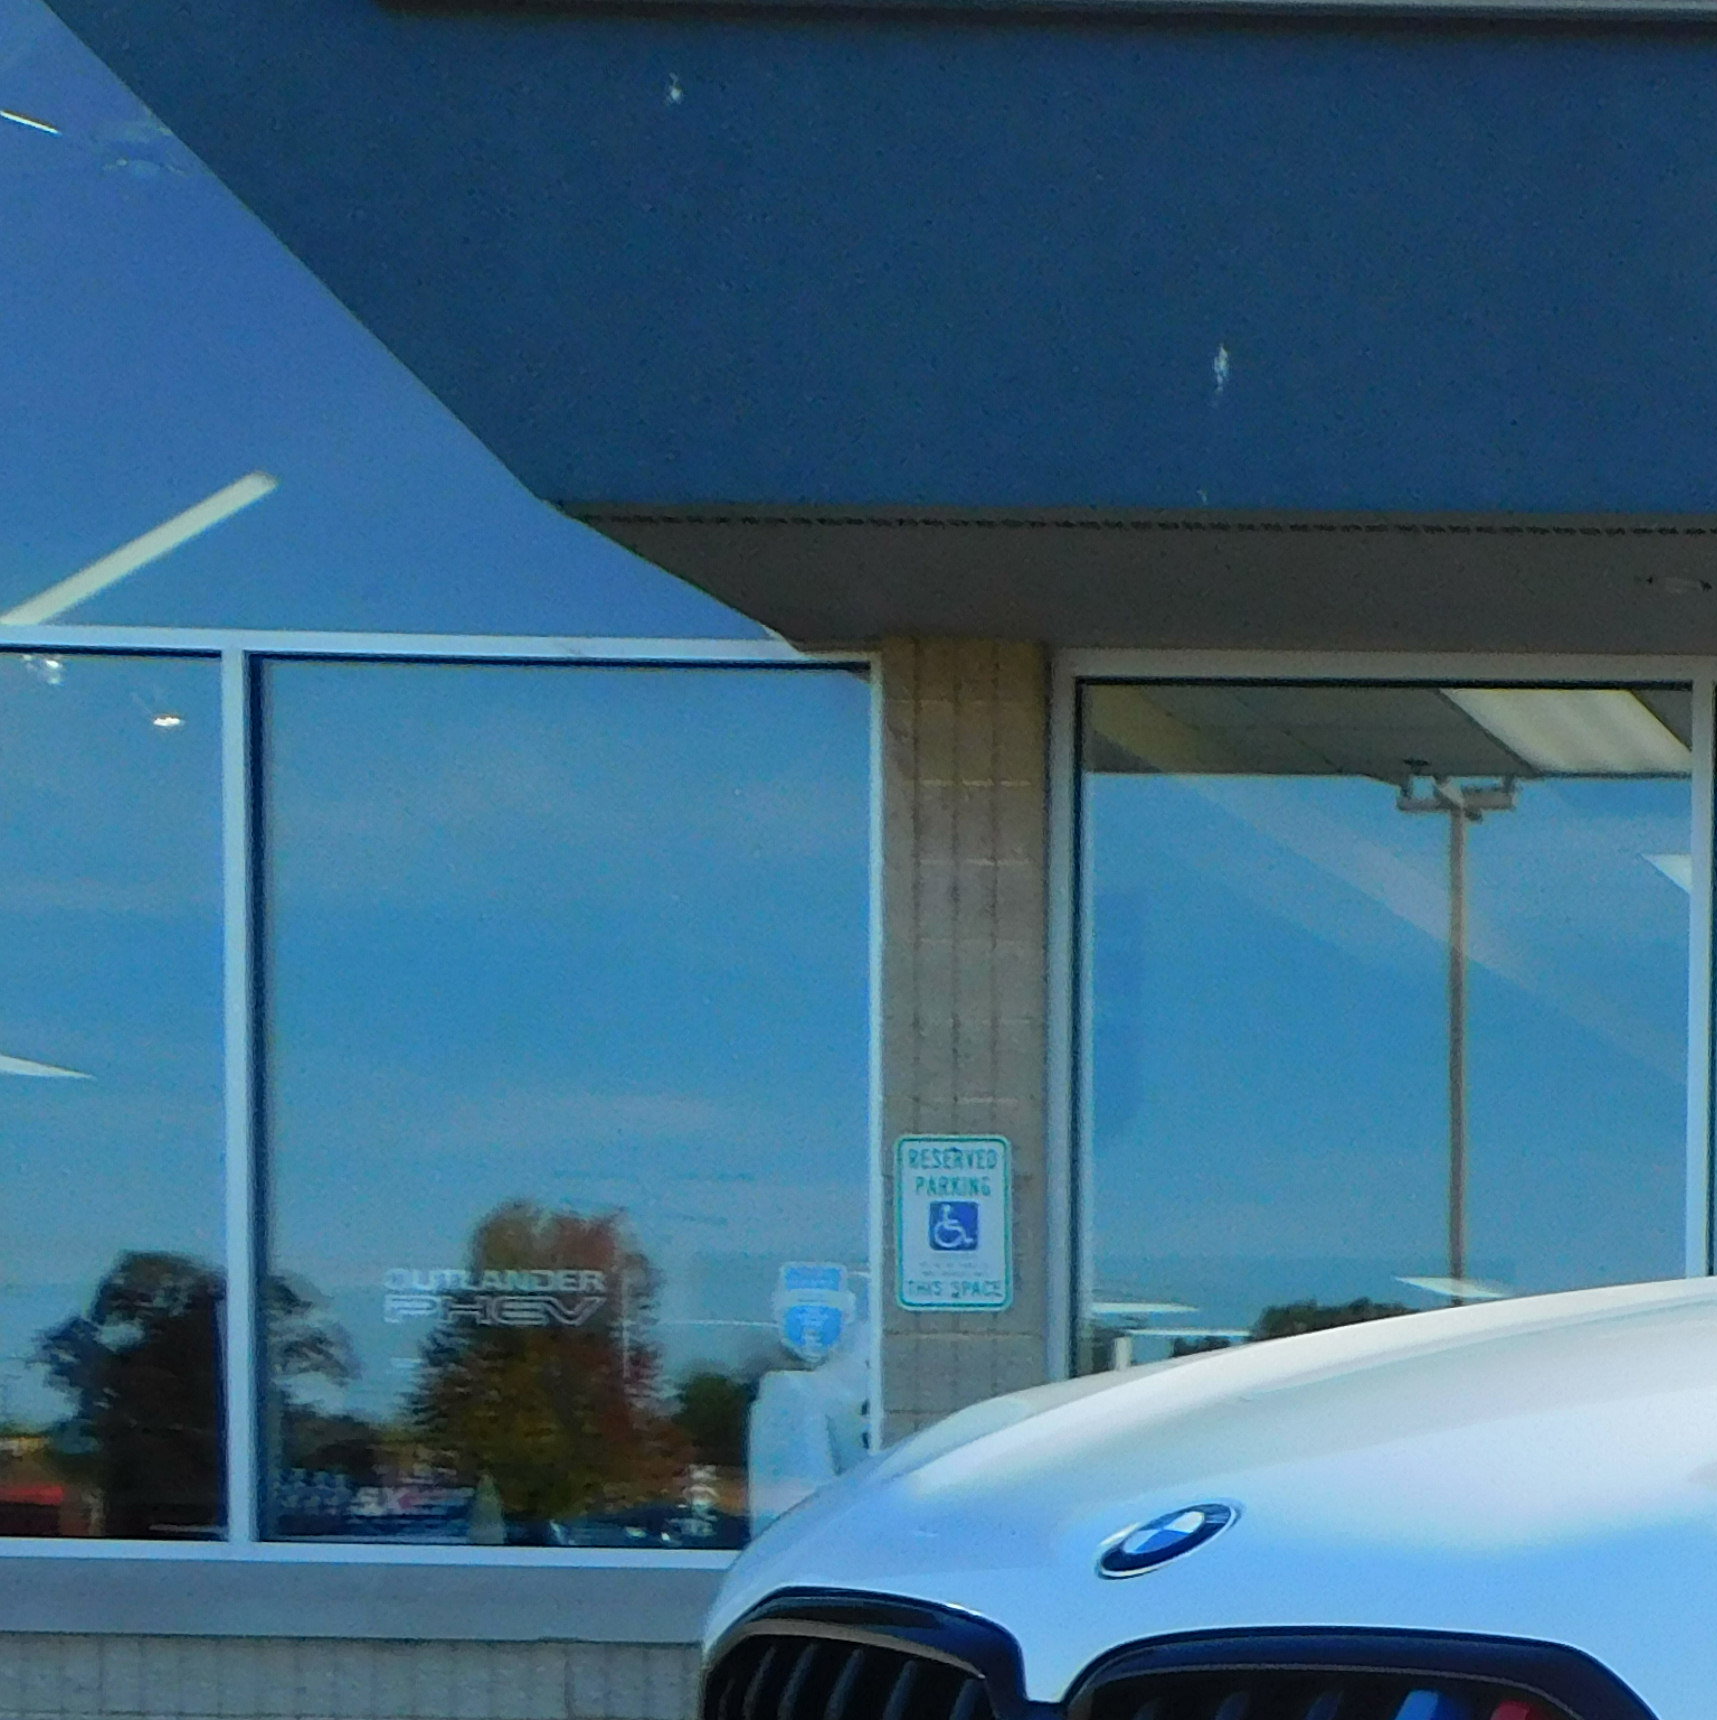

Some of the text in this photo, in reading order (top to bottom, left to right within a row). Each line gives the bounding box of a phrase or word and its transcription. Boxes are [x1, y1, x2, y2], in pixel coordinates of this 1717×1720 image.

[908, 1148, 998, 1169] RESERVED
[915, 1175, 992, 1197] PARKING
[383, 1268, 606, 1291] OUTLANDER
[908, 1280, 1003, 1298] THIS SPACE
[384, 1295, 607, 1327] PHEV
